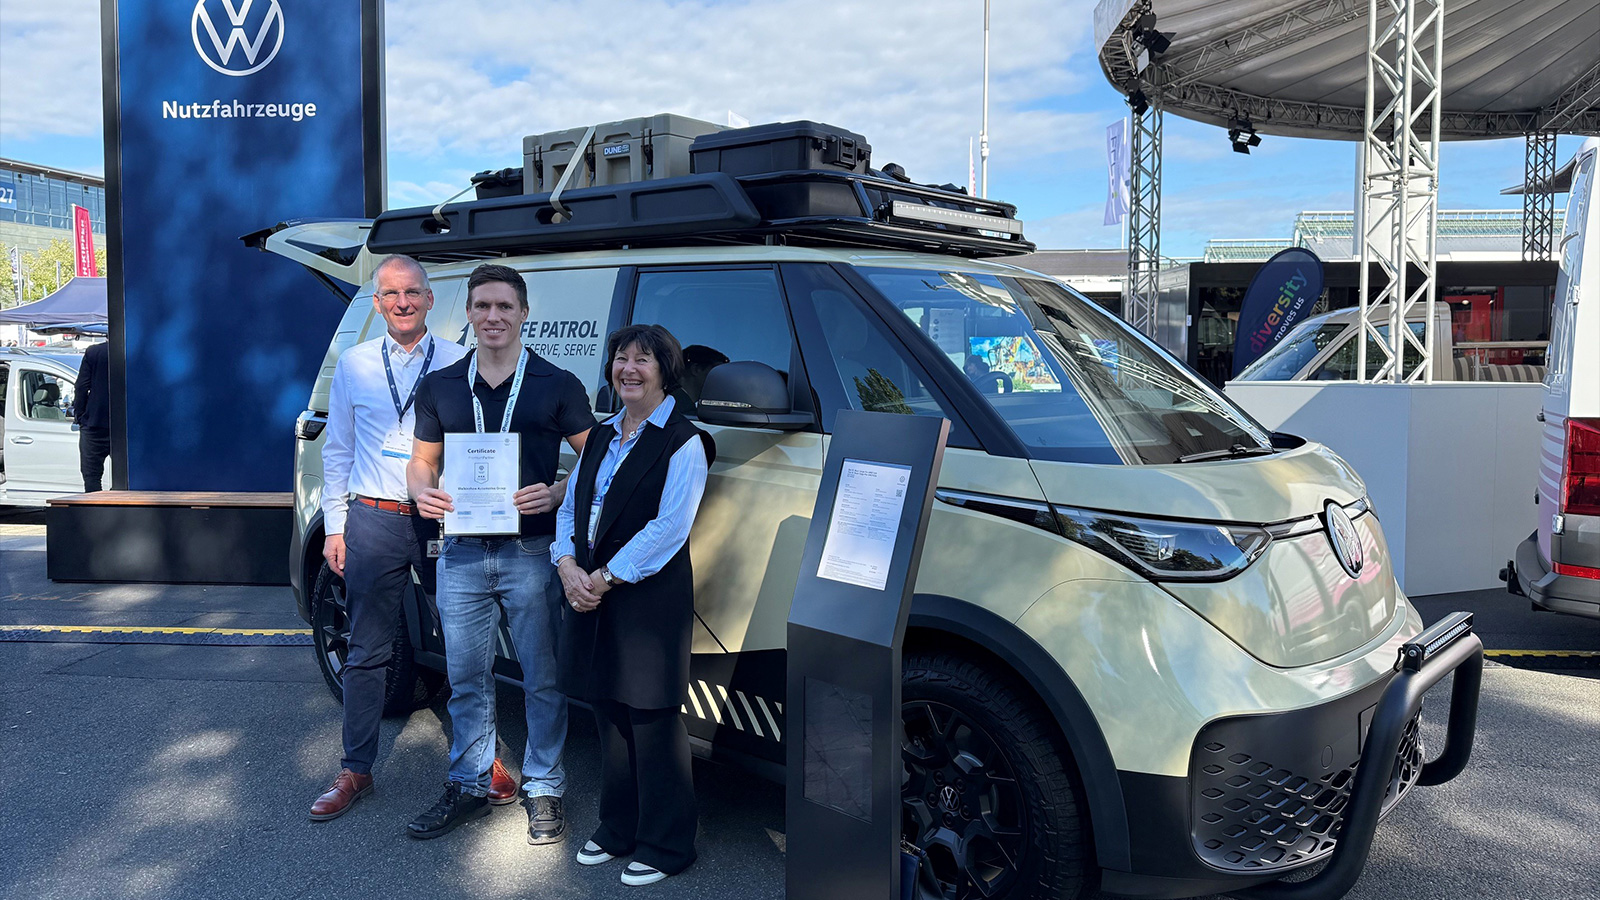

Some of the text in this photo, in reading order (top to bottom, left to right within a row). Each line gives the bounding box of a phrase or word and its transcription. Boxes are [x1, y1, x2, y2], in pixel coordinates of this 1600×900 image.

[162, 99, 317, 122] Nutzfahrzeuge
[604, 146, 621, 155] DUNE
[1250, 268, 1308, 353] diversity
[1274, 297, 1305, 341] moves us
[539, 320, 599, 338] PATROL
[563, 343, 597, 356] SERVE
